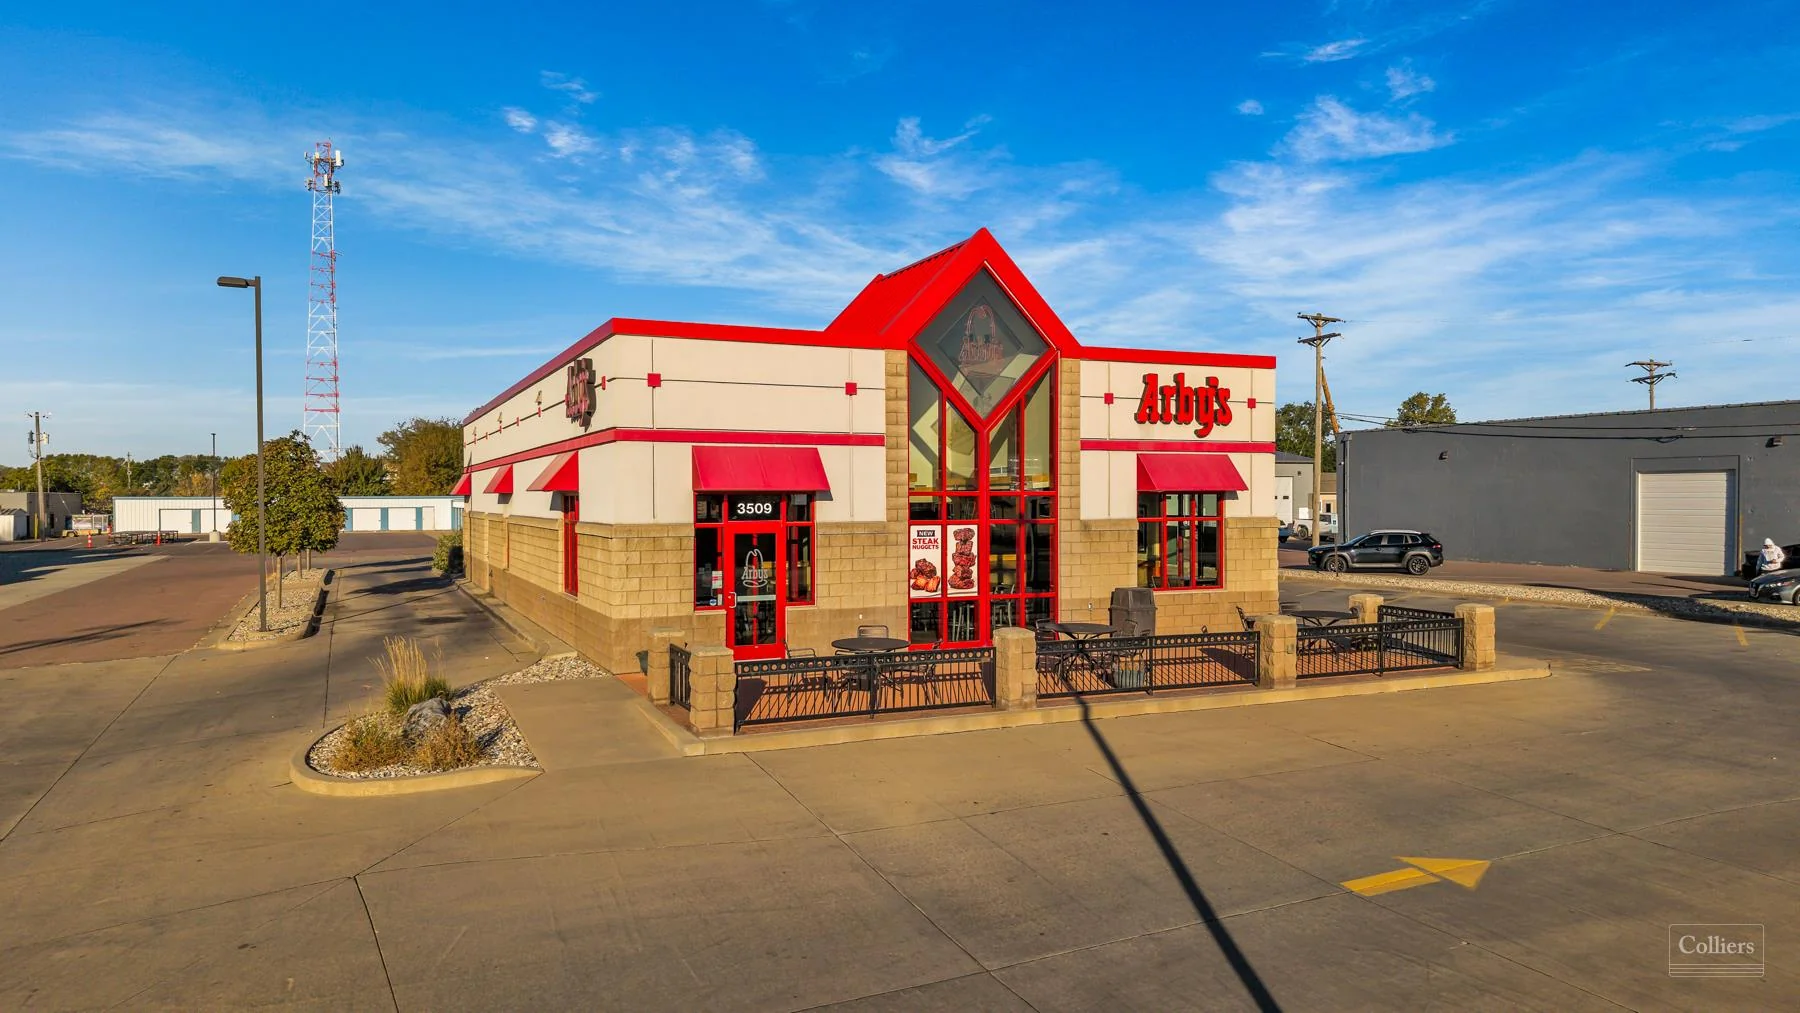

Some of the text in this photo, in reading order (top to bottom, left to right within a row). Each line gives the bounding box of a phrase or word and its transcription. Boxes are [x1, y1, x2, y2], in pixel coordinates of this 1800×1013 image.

[1134, 372, 1233, 438] Arby's
[737, 502, 772, 514] 3509
[912, 537, 939, 545] STEAK
